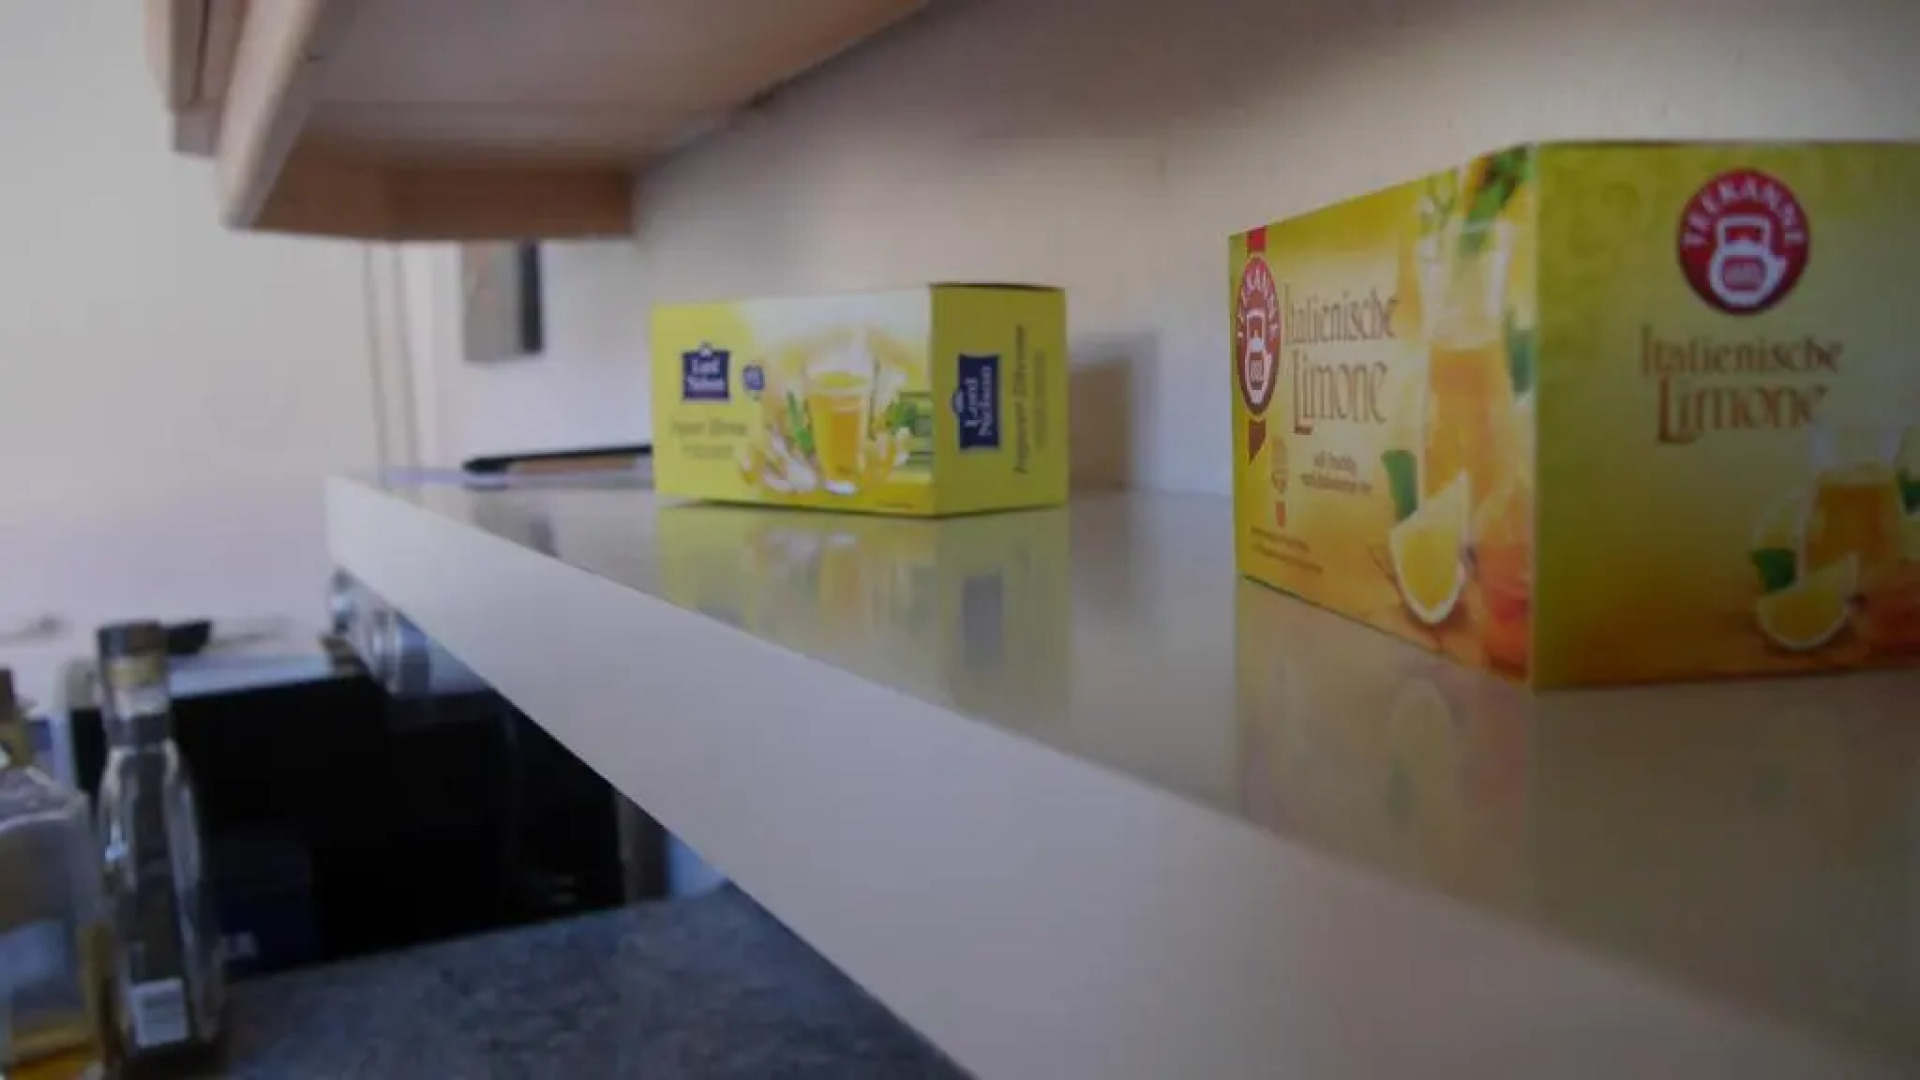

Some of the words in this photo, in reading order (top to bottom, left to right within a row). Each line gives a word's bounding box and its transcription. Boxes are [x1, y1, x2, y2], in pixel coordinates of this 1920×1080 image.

[1680, 176, 1806, 246] TEEKANNE
[1236, 267, 1279, 340] TEEKANNE
[1282, 283, 1398, 345] Italienische
[1640, 322, 1845, 377] Italienische
[964, 377, 982, 428] Lord
[978, 365, 993, 437] Nelson
[1293, 350, 1388, 435] Limone
[1657, 374, 1829, 444] Limone
